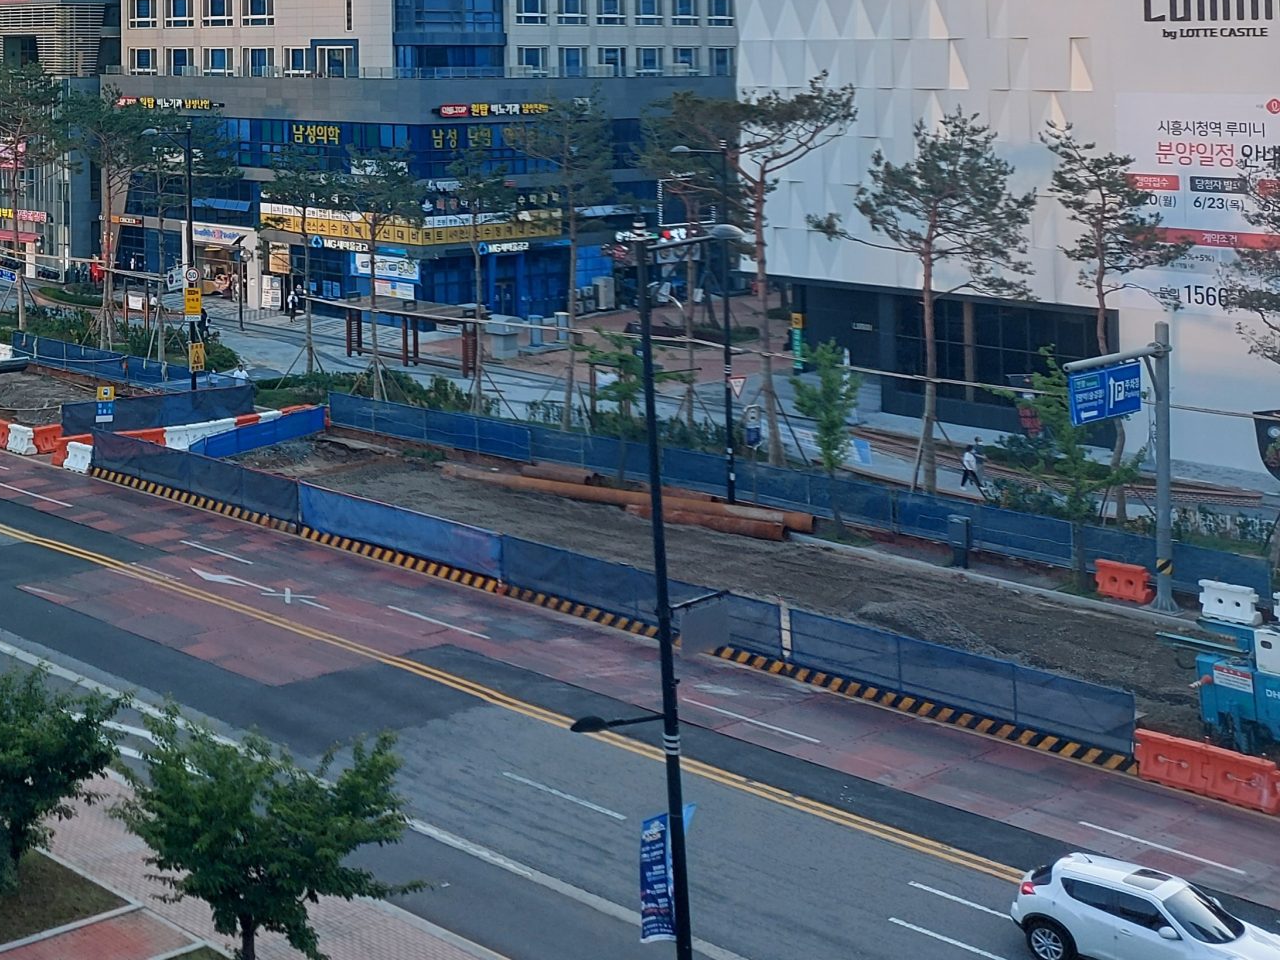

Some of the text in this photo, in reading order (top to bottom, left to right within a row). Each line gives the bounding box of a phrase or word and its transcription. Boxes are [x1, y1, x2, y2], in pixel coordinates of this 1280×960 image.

[1162, 27, 1269, 40] by LOTTE CASTLE
[156, 98, 183, 109] 비뇨기과
[470, 103, 489, 116] 원탑
[490, 103, 520, 115] 비뇨기과
[292, 124, 341, 145] 남성의학
[1157, 120, 1266, 138] 시흥시청역 루미니
[431, 129, 458, 149] 남성
[1155, 141, 1235, 168] 분양일정
[1195, 178, 1221, 191] 당첨자
[1193, 195, 1245, 212] 6/23(목)
[1202, 232, 1238, 245] 계약조건
